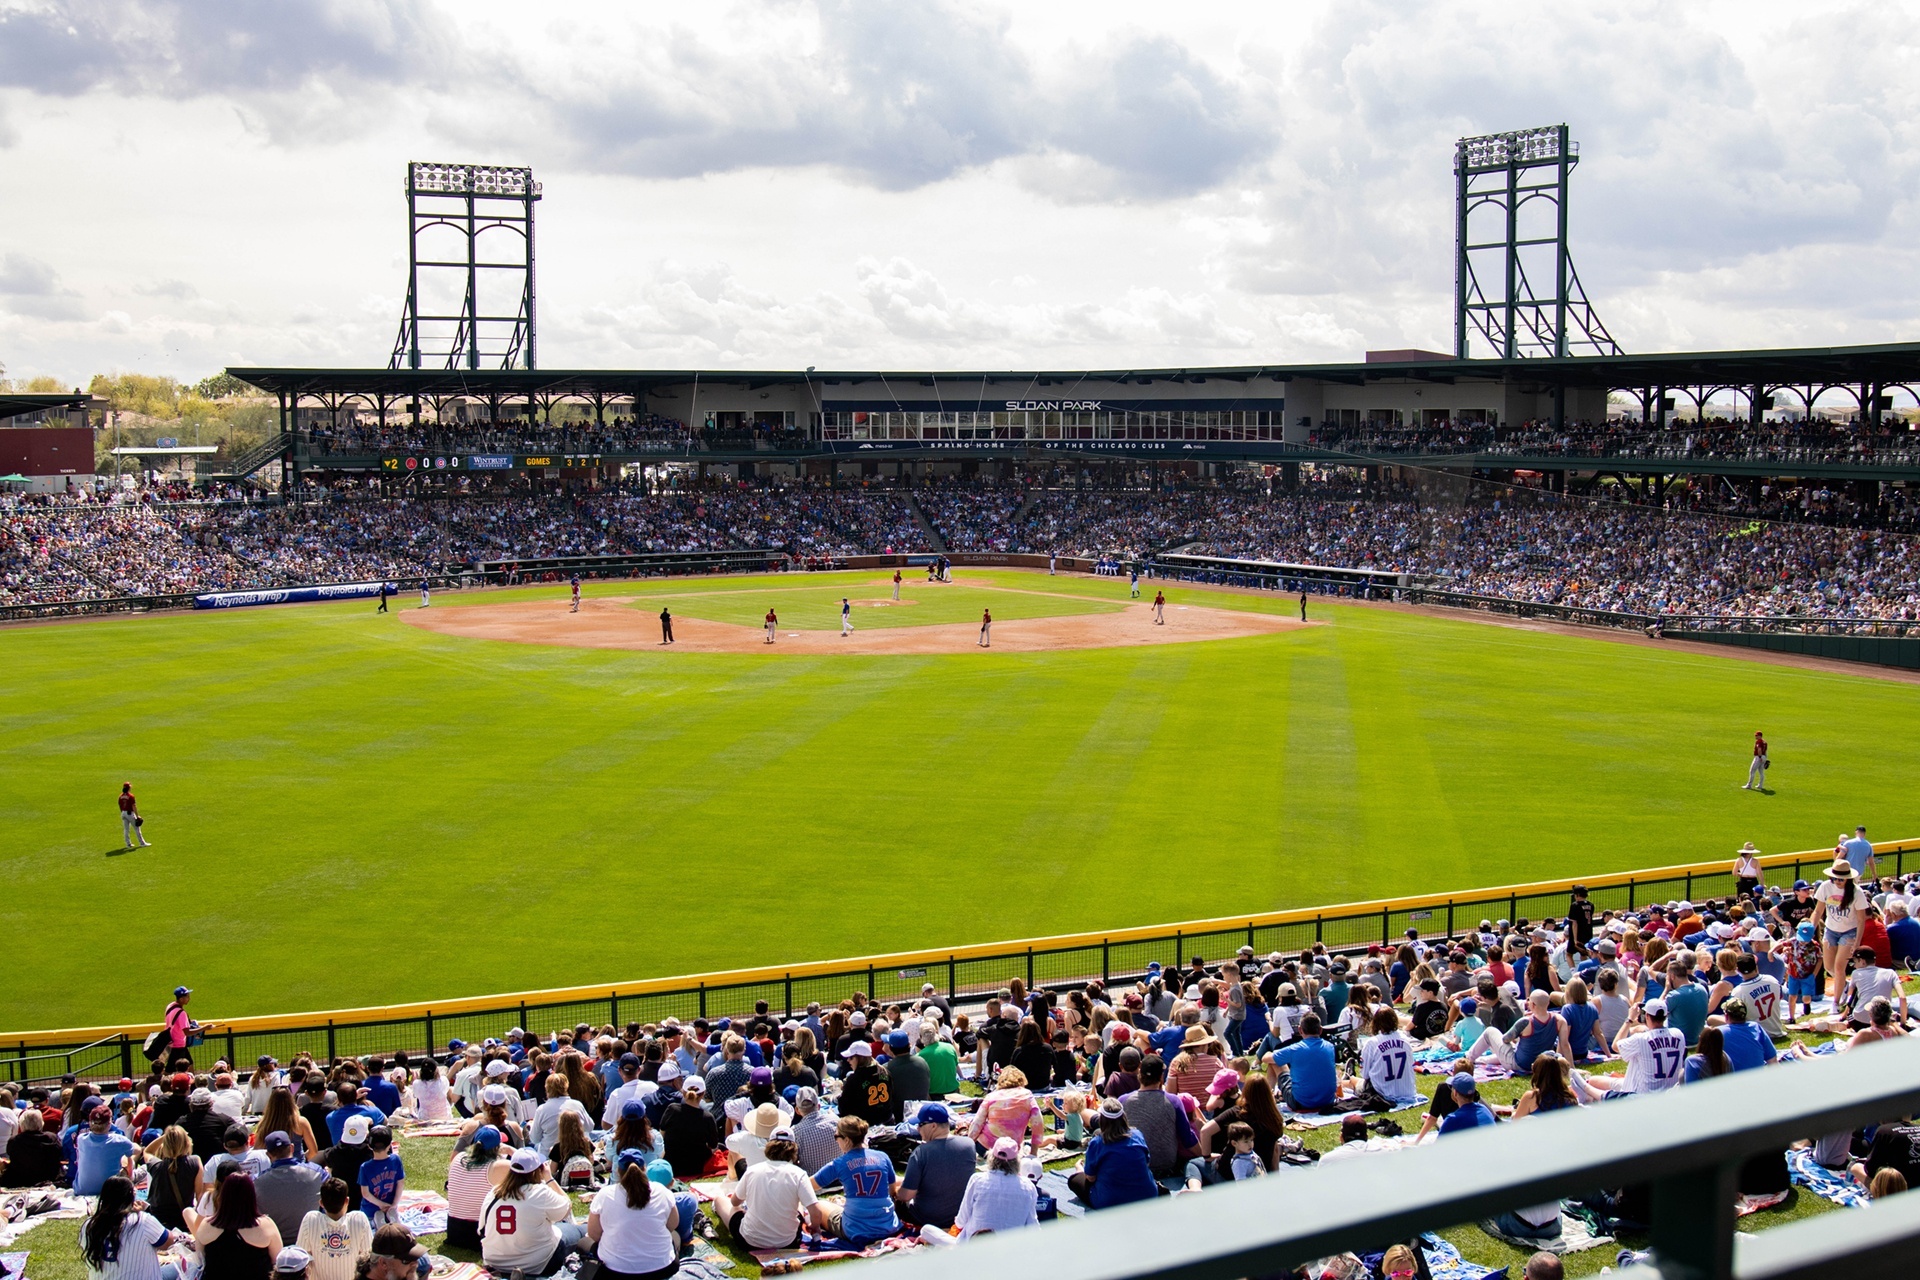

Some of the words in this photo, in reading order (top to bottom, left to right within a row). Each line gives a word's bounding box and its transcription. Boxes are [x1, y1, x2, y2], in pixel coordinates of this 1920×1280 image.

[1005, 401, 1059, 411] SLOAN
[1062, 401, 1101, 411] PARK
[391, 458, 398, 469] 2
[423, 457, 430, 468] 0
[451, 456, 458, 468] 0
[473, 456, 508, 464] WINTRUST
[526, 457, 551, 466] GOMES
[566, 458, 572, 467] 3
[580, 458, 586, 467] 2
[318, 586, 356, 597] Reynolds
[357, 585, 380, 595] Wrap
[214, 594, 257, 608] Reynolds
[257, 592, 282, 603] Wrap
[1749, 984, 1771, 999] BRYANT
[1755, 992, 1776, 1022] 17
[1378, 1039, 1404, 1053] BRYANT
[1648, 1036, 1681, 1051] BRYANT
[1382, 1051, 1407, 1082] 17
[1653, 1050, 1680, 1079] 17
[868, 1082, 889, 1106] 23
[852, 1170, 883, 1197] 17
[496, 1205, 516, 1235] 8
